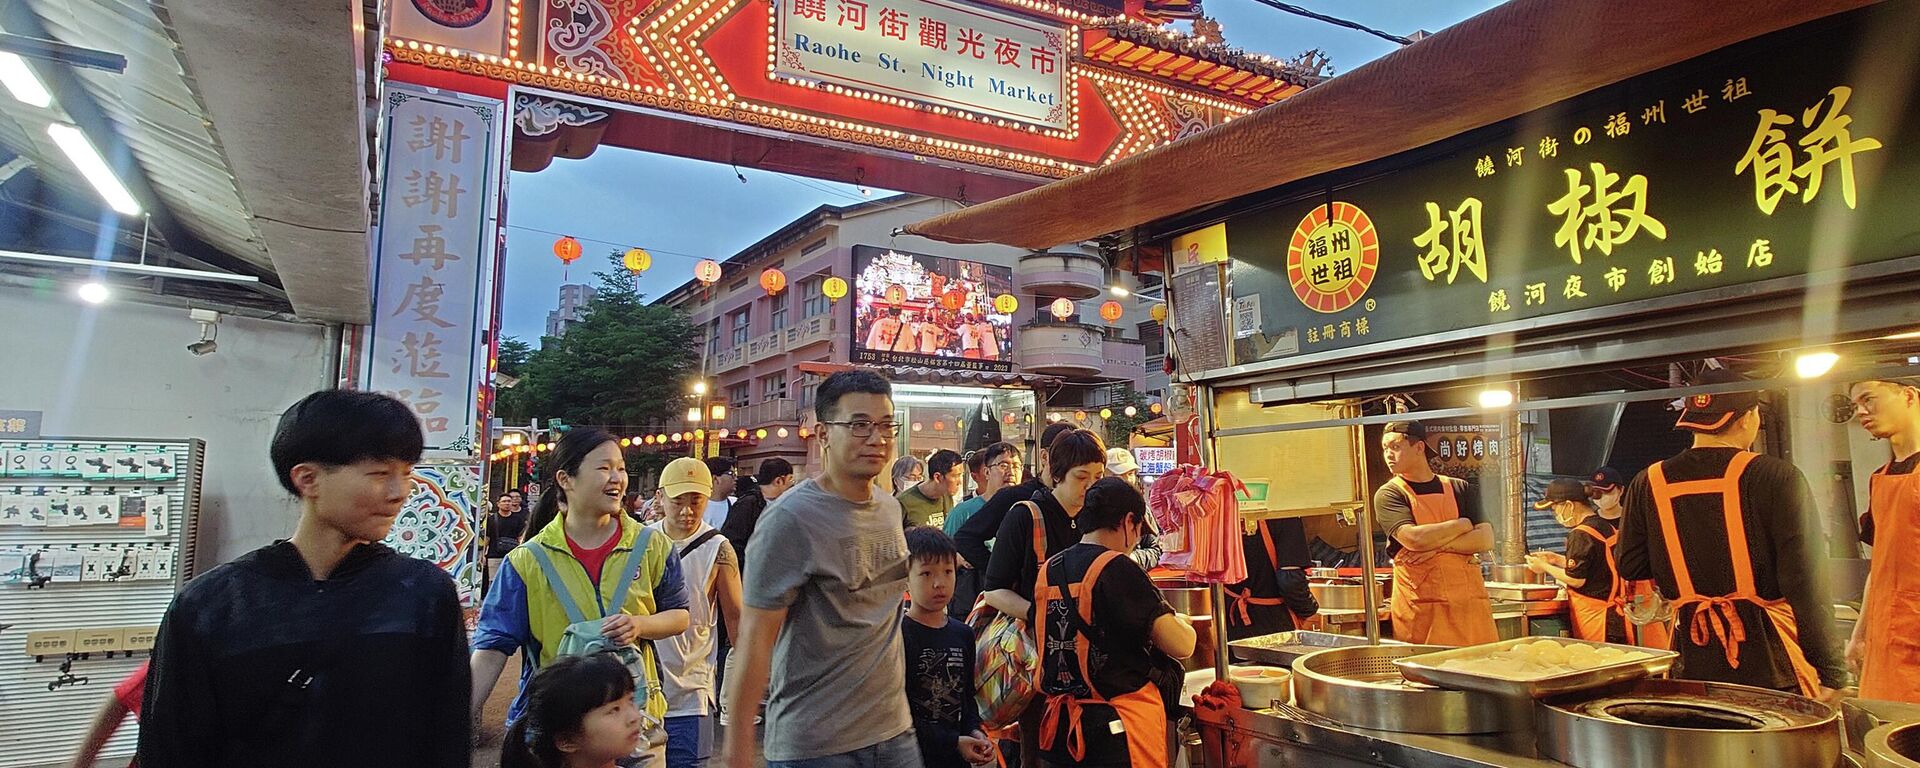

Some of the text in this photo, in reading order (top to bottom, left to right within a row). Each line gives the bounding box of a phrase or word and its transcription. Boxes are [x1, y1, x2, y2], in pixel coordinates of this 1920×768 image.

[793, 0, 1056, 75] 饒河街觀光夜市
[795, 33, 1054, 105] Raohe St. Night Market
[1475, 76, 1752, 178] 饒河街の福州世祖
[1413, 86, 1882, 285] 胡椒餅
[1308, 229, 1350, 260] 福州
[1310, 257, 1353, 286] 世祖
[1488, 239, 1774, 312] 饒河夜市創始店
[1306, 316, 1370, 343] 註冊商標
[993, 364, 1009, 372] 2023
[1440, 440, 1498, 457] 尚好烤肉
[926, 514, 944, 527] Jee
